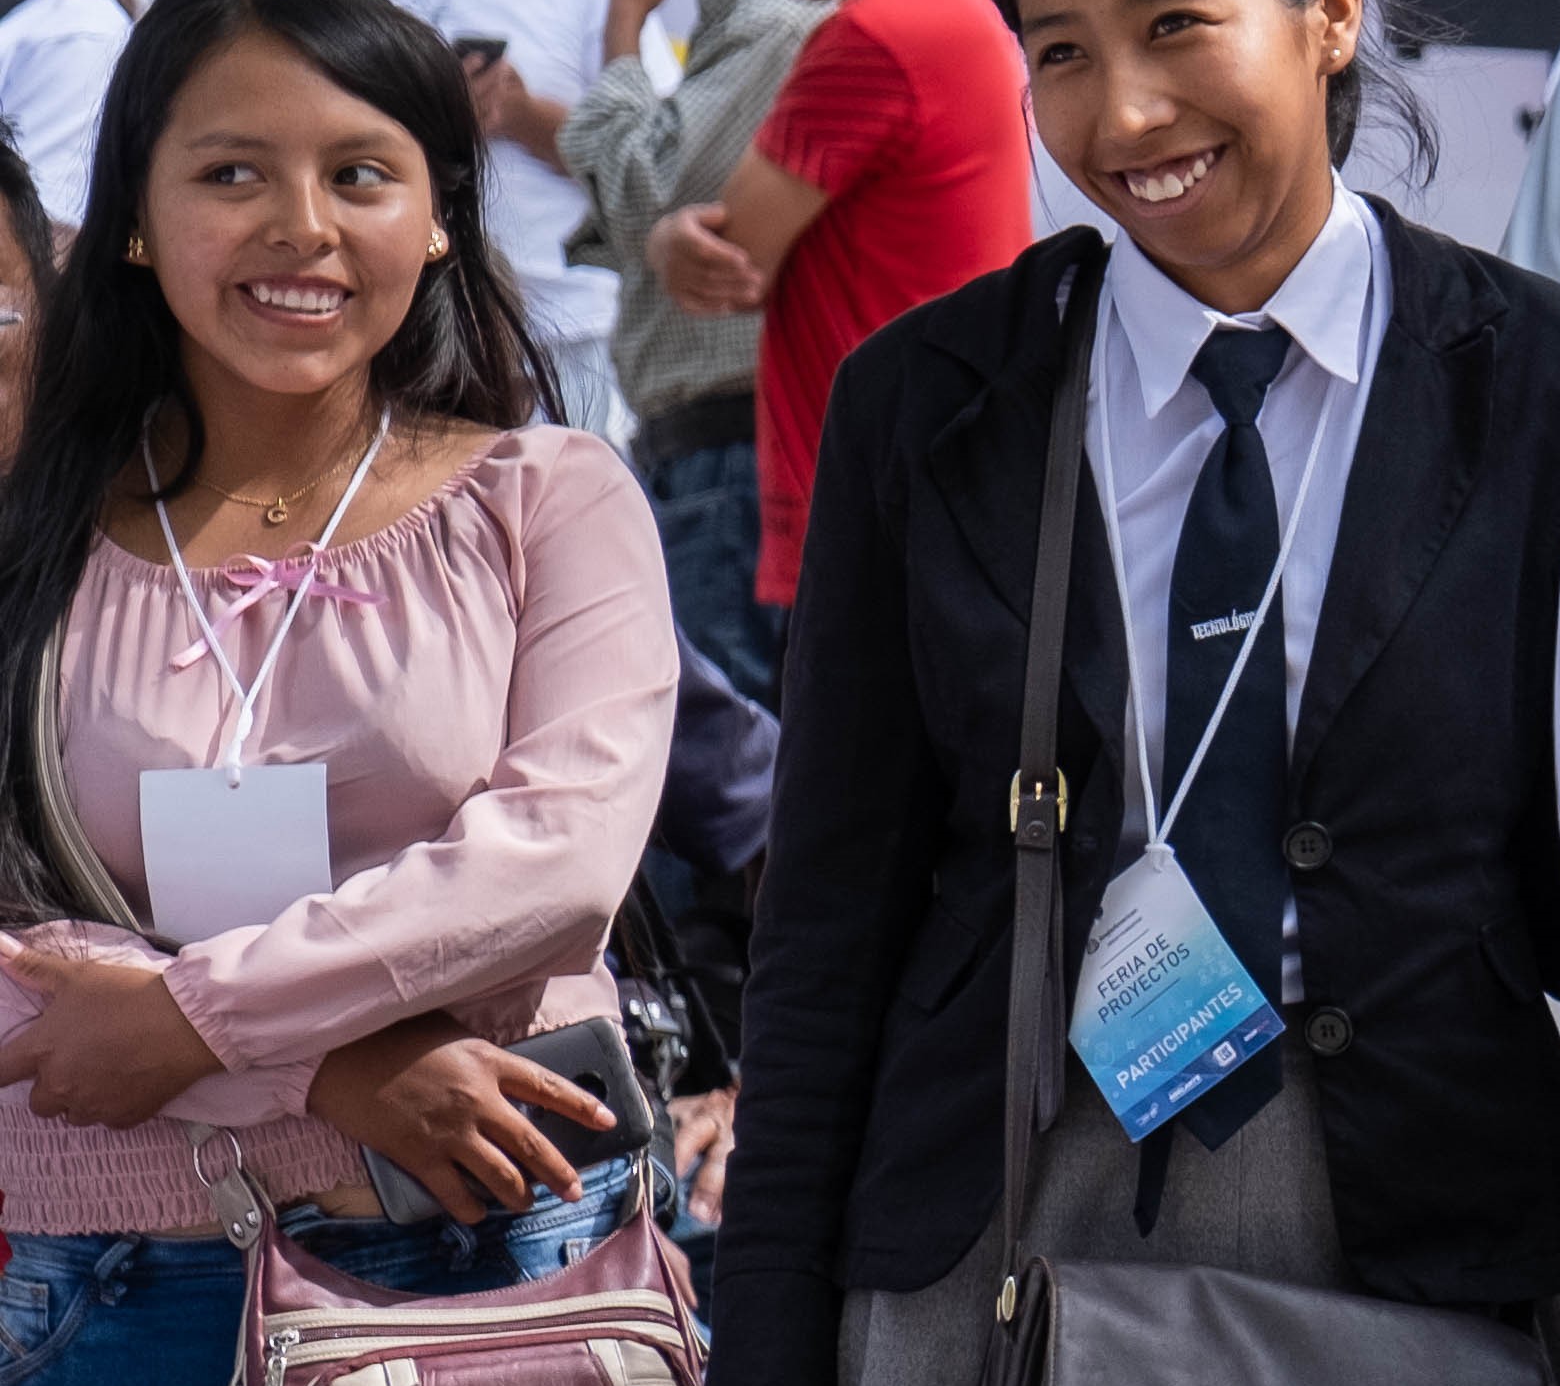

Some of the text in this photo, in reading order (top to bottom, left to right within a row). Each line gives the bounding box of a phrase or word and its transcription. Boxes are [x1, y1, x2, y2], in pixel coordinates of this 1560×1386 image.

[1097, 933, 1170, 1000] FERIA DE
[1097, 943, 1191, 1025] PROYECTOS
[1116, 981, 1244, 1091] PARTICIPANTES
